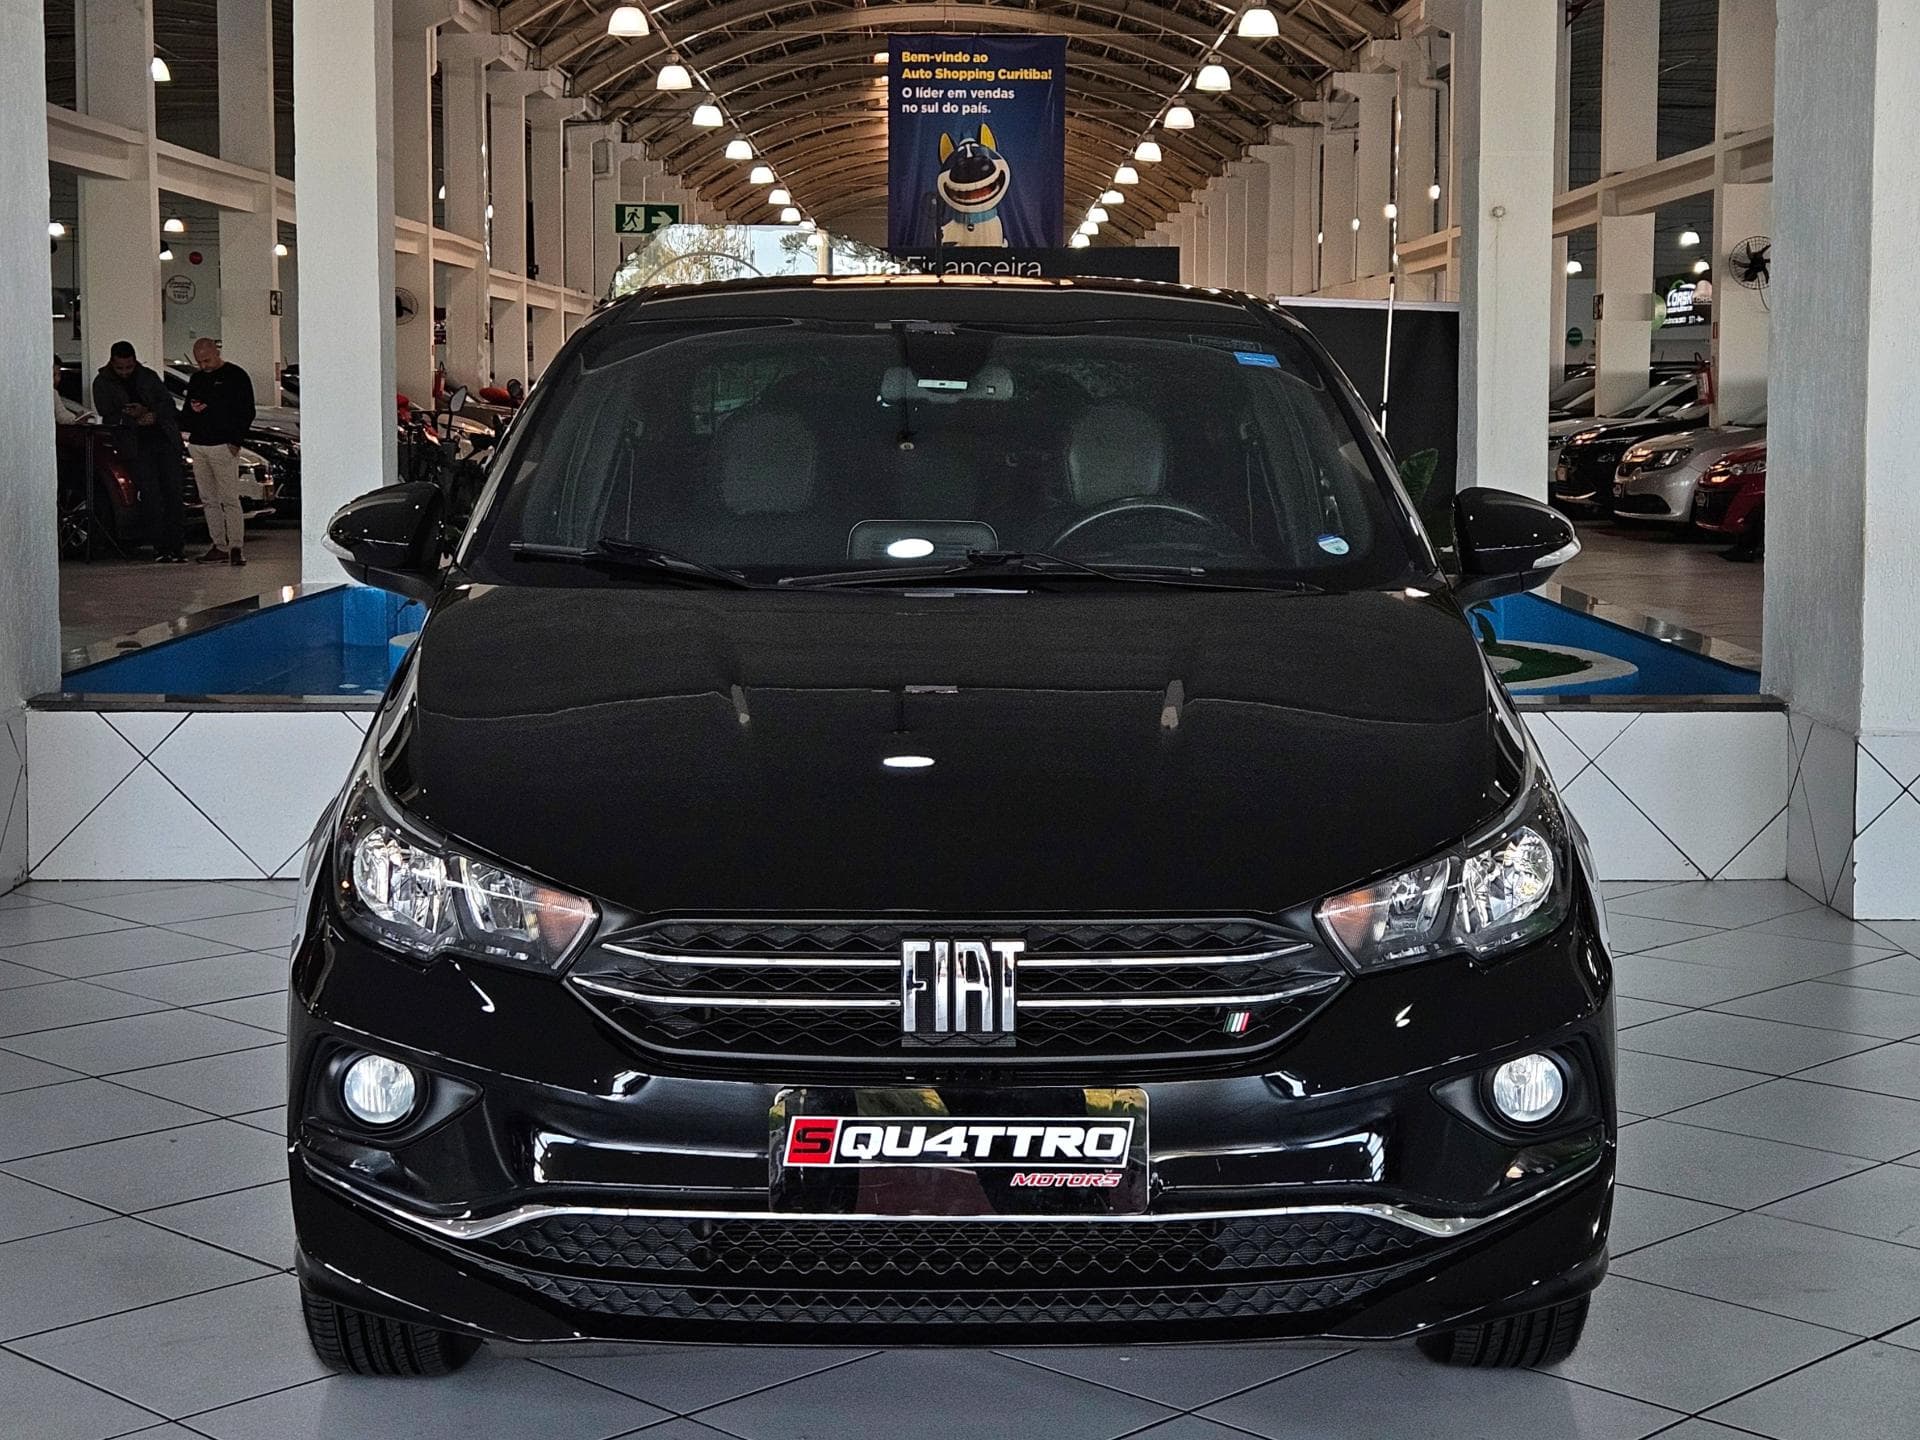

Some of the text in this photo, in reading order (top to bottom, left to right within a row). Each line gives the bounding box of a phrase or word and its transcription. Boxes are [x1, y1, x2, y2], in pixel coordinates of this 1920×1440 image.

[902, 51, 989, 63] Bem-vindo ao
[902, 68, 1052, 81] Auto Shopping Curitiba!
[902, 87, 1015, 99] O líder em vendas
[902, 102, 991, 115] no sul do país.
[902, 940, 1026, 1032] FIAT
[1010, 1173, 1122, 1187] MOTORS
